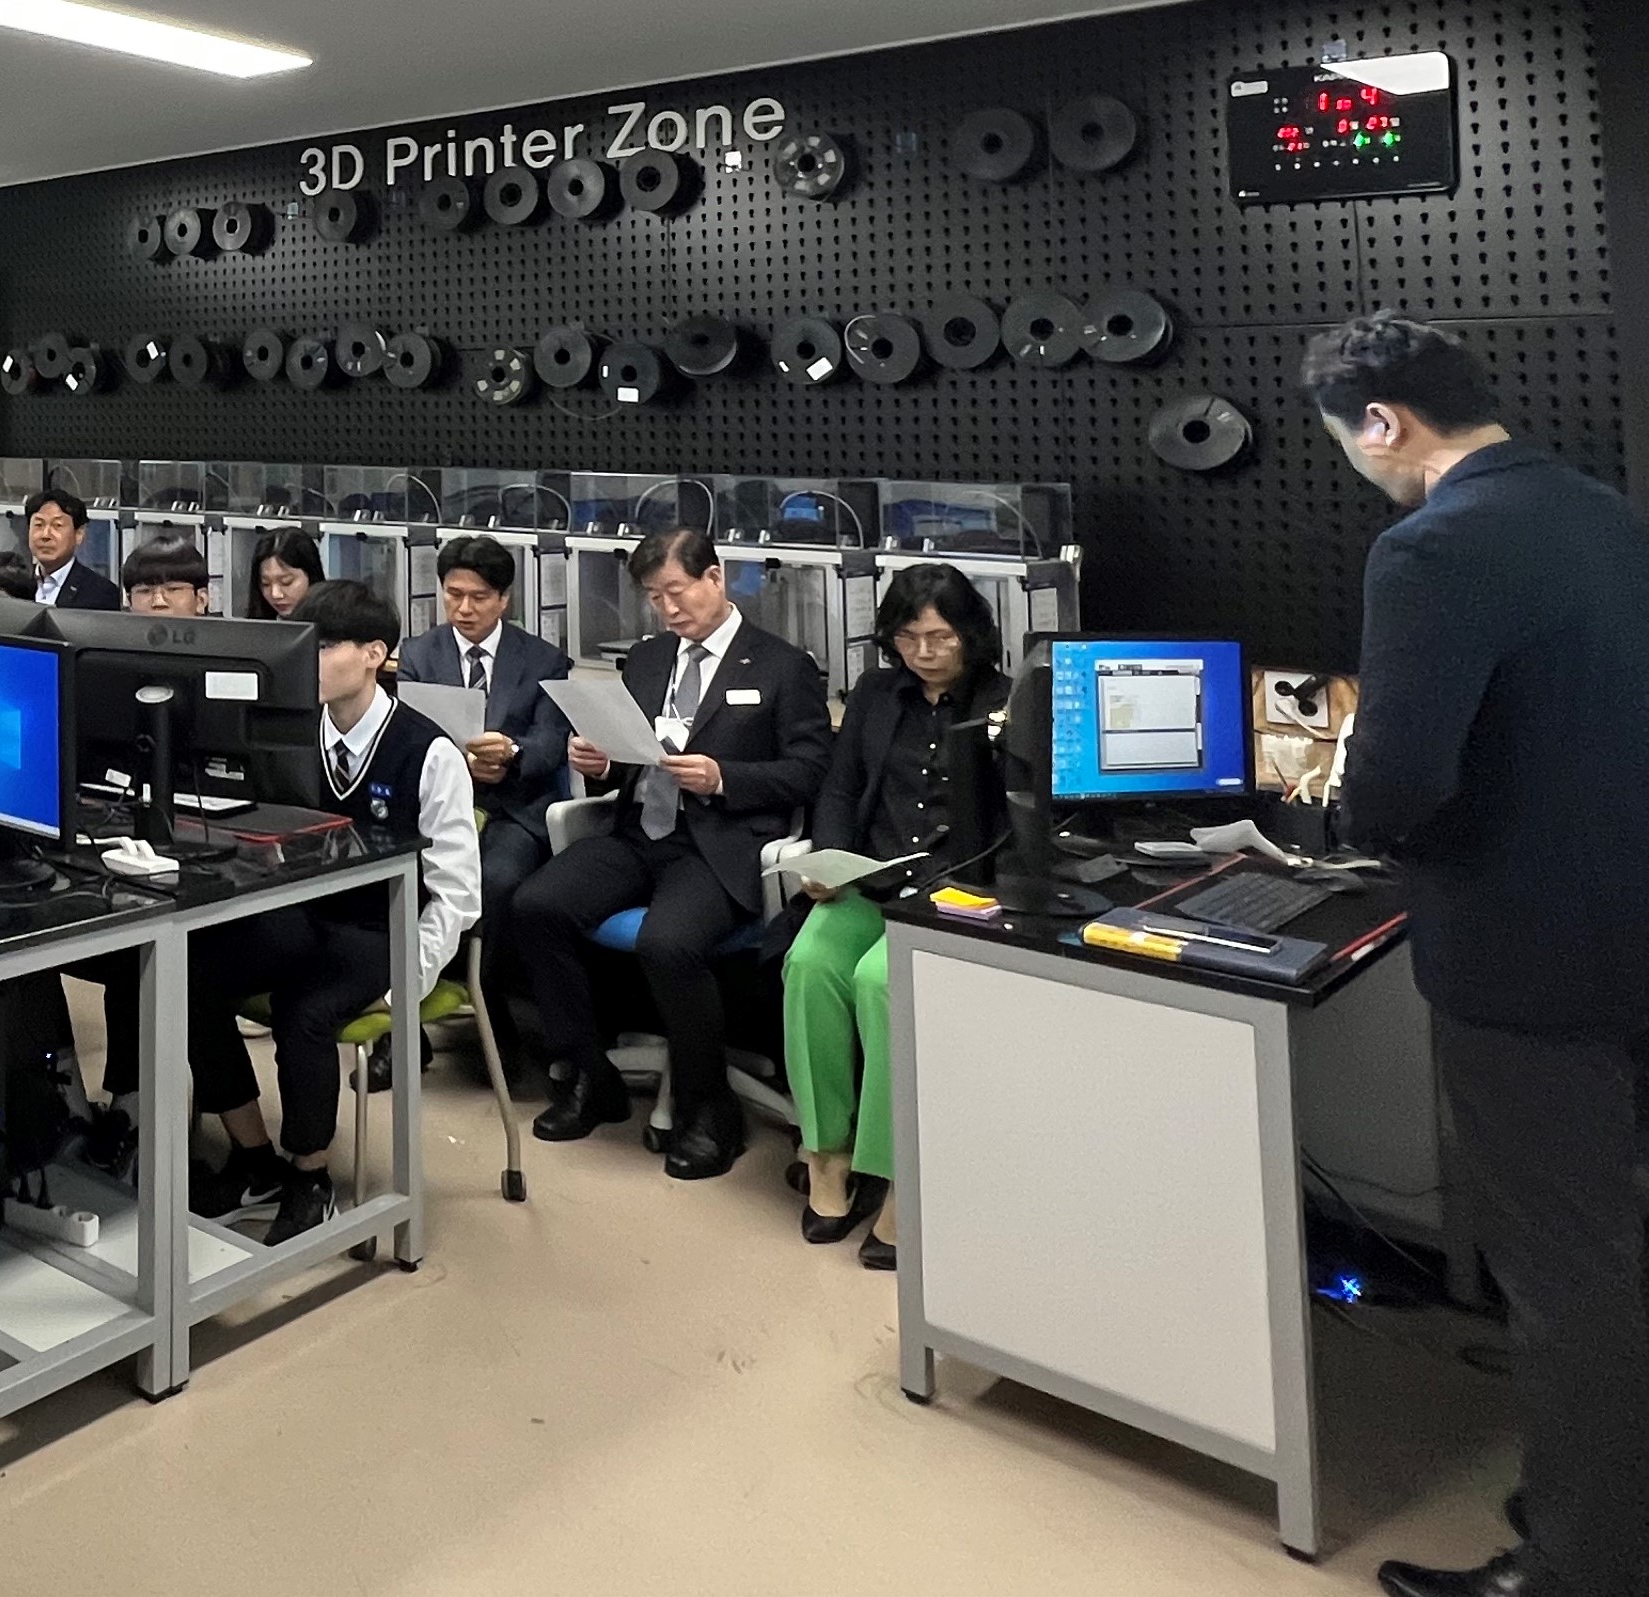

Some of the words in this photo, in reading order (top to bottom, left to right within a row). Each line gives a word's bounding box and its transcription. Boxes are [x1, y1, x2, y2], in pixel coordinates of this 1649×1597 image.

[299, 144, 364, 196] 3D
[387, 123, 585, 185] Printer
[607, 97, 786, 159] Zone
